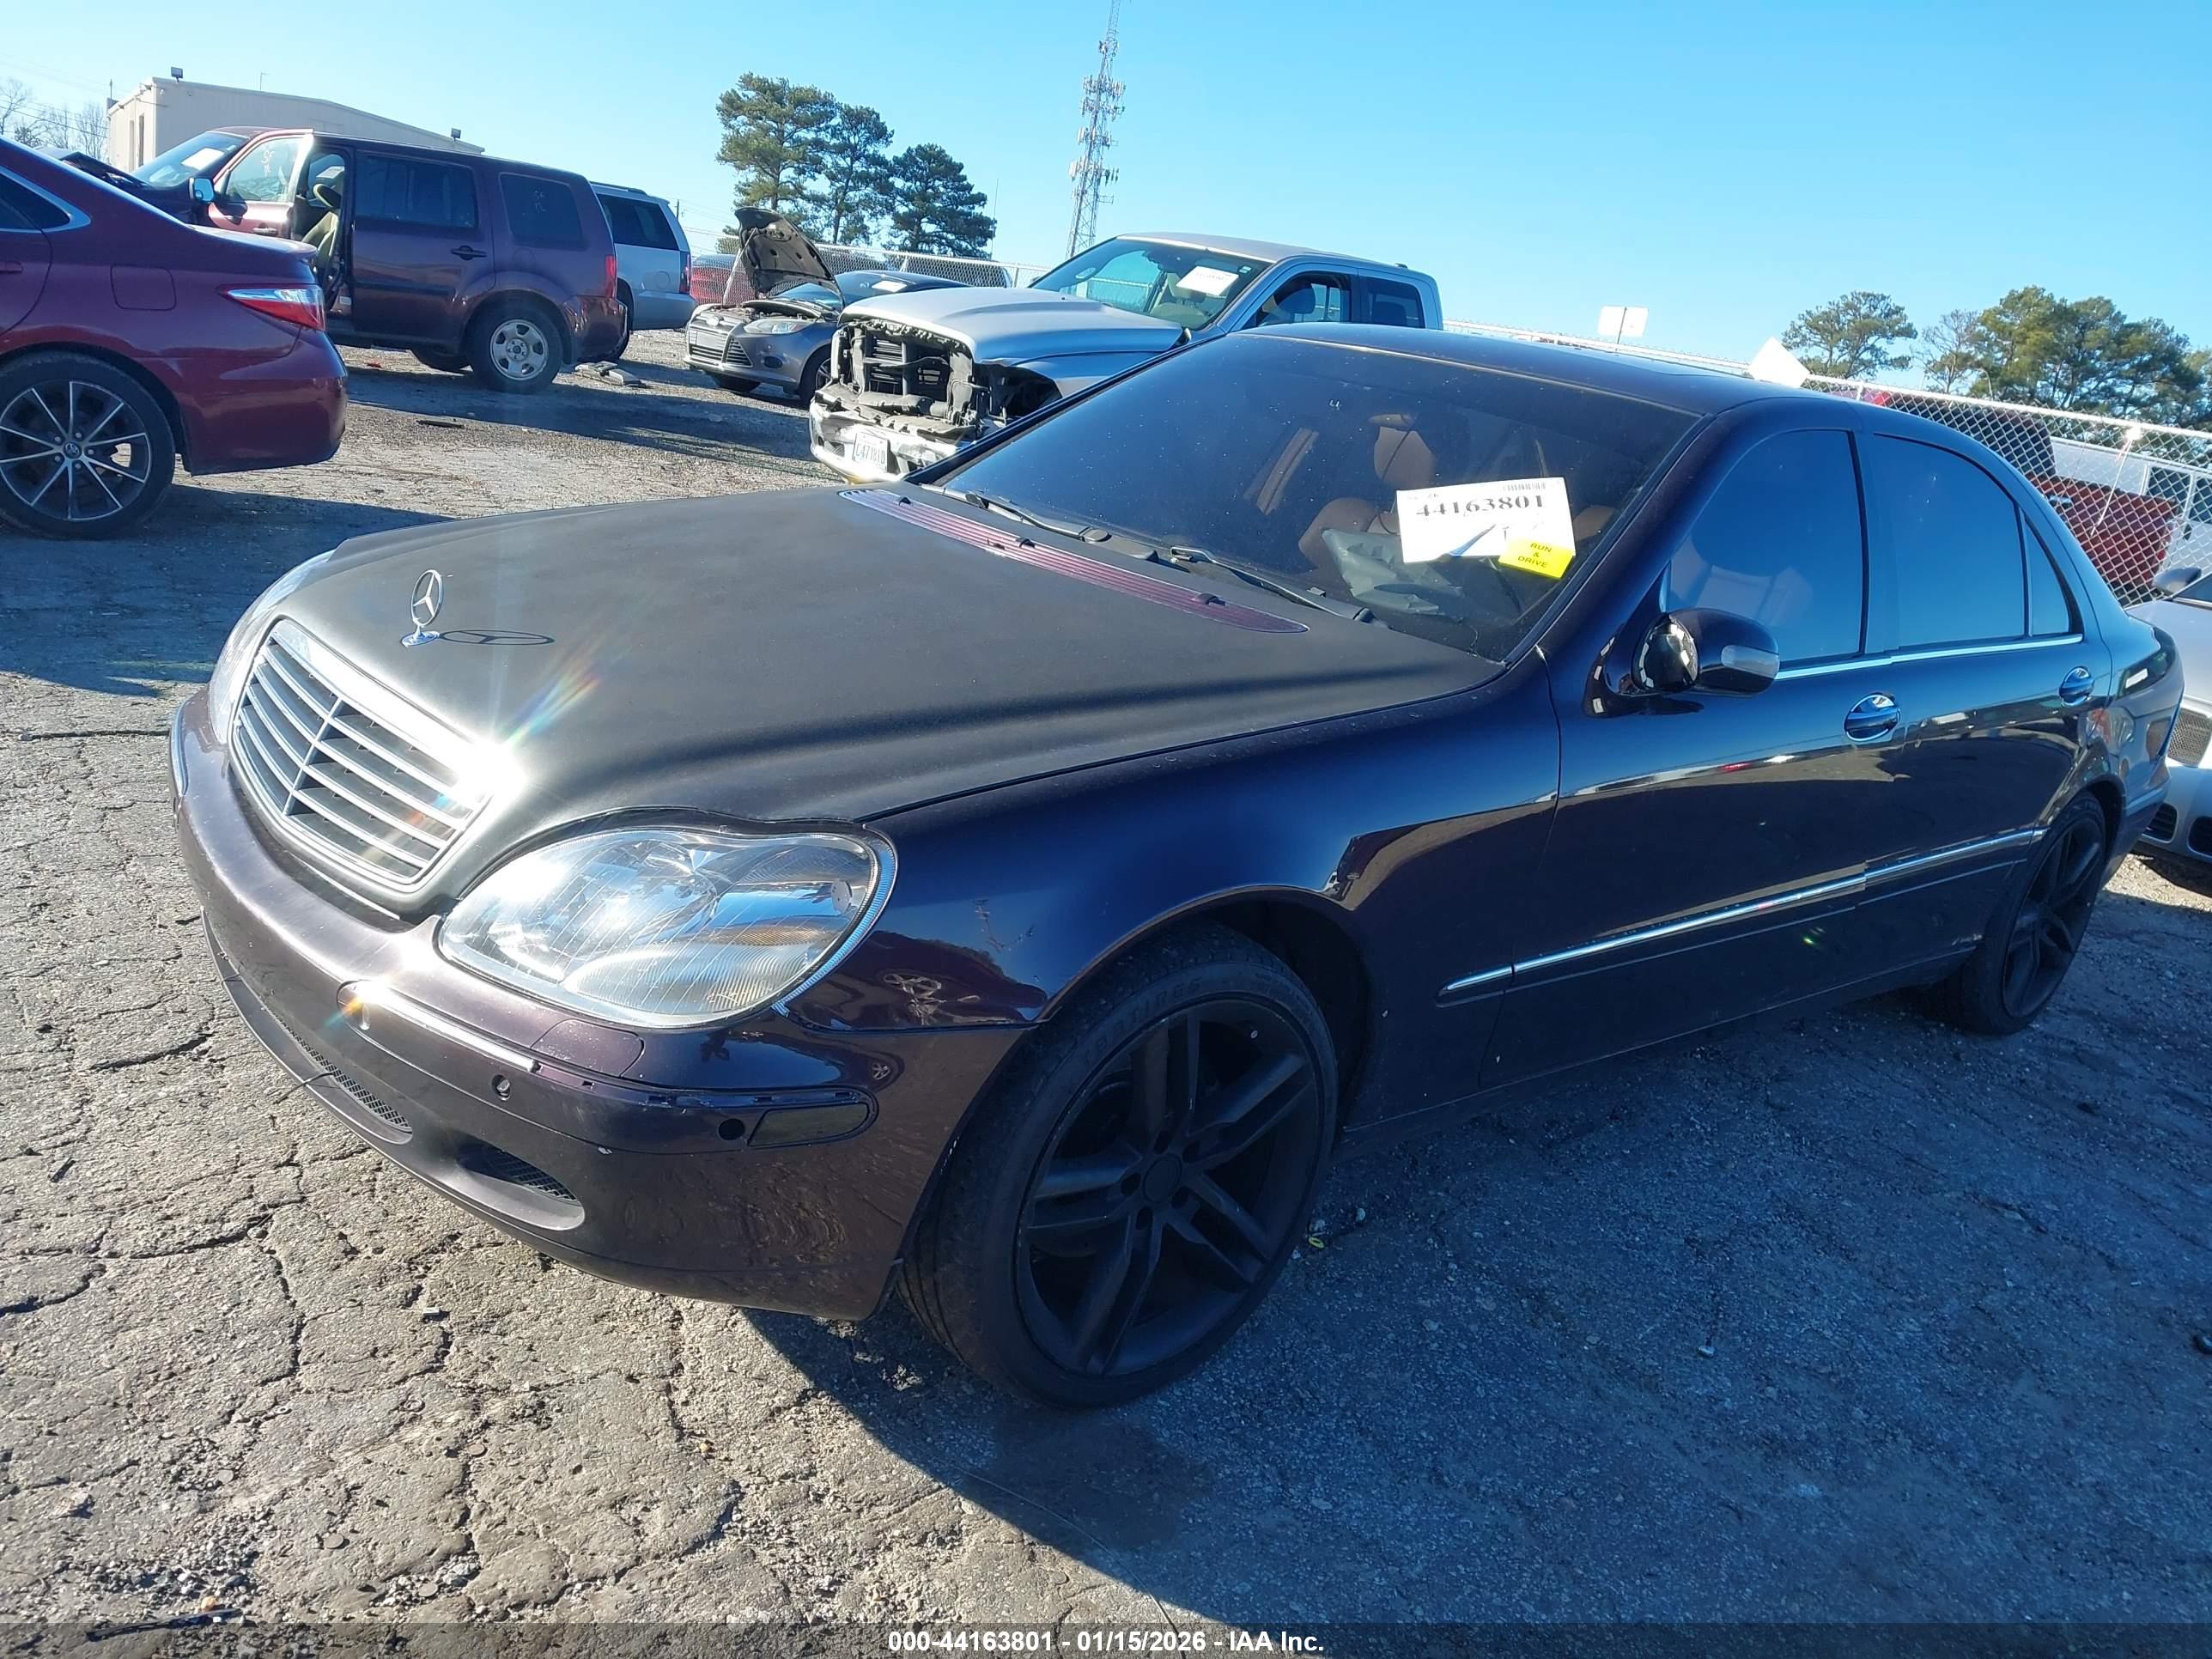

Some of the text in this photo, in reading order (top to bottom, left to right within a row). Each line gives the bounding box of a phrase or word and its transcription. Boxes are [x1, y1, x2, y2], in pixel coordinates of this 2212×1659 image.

[1416, 495, 1543, 517] 44163801
[1530, 543, 1553, 553] RUN
[1517, 556, 1548, 568] DRIVE
